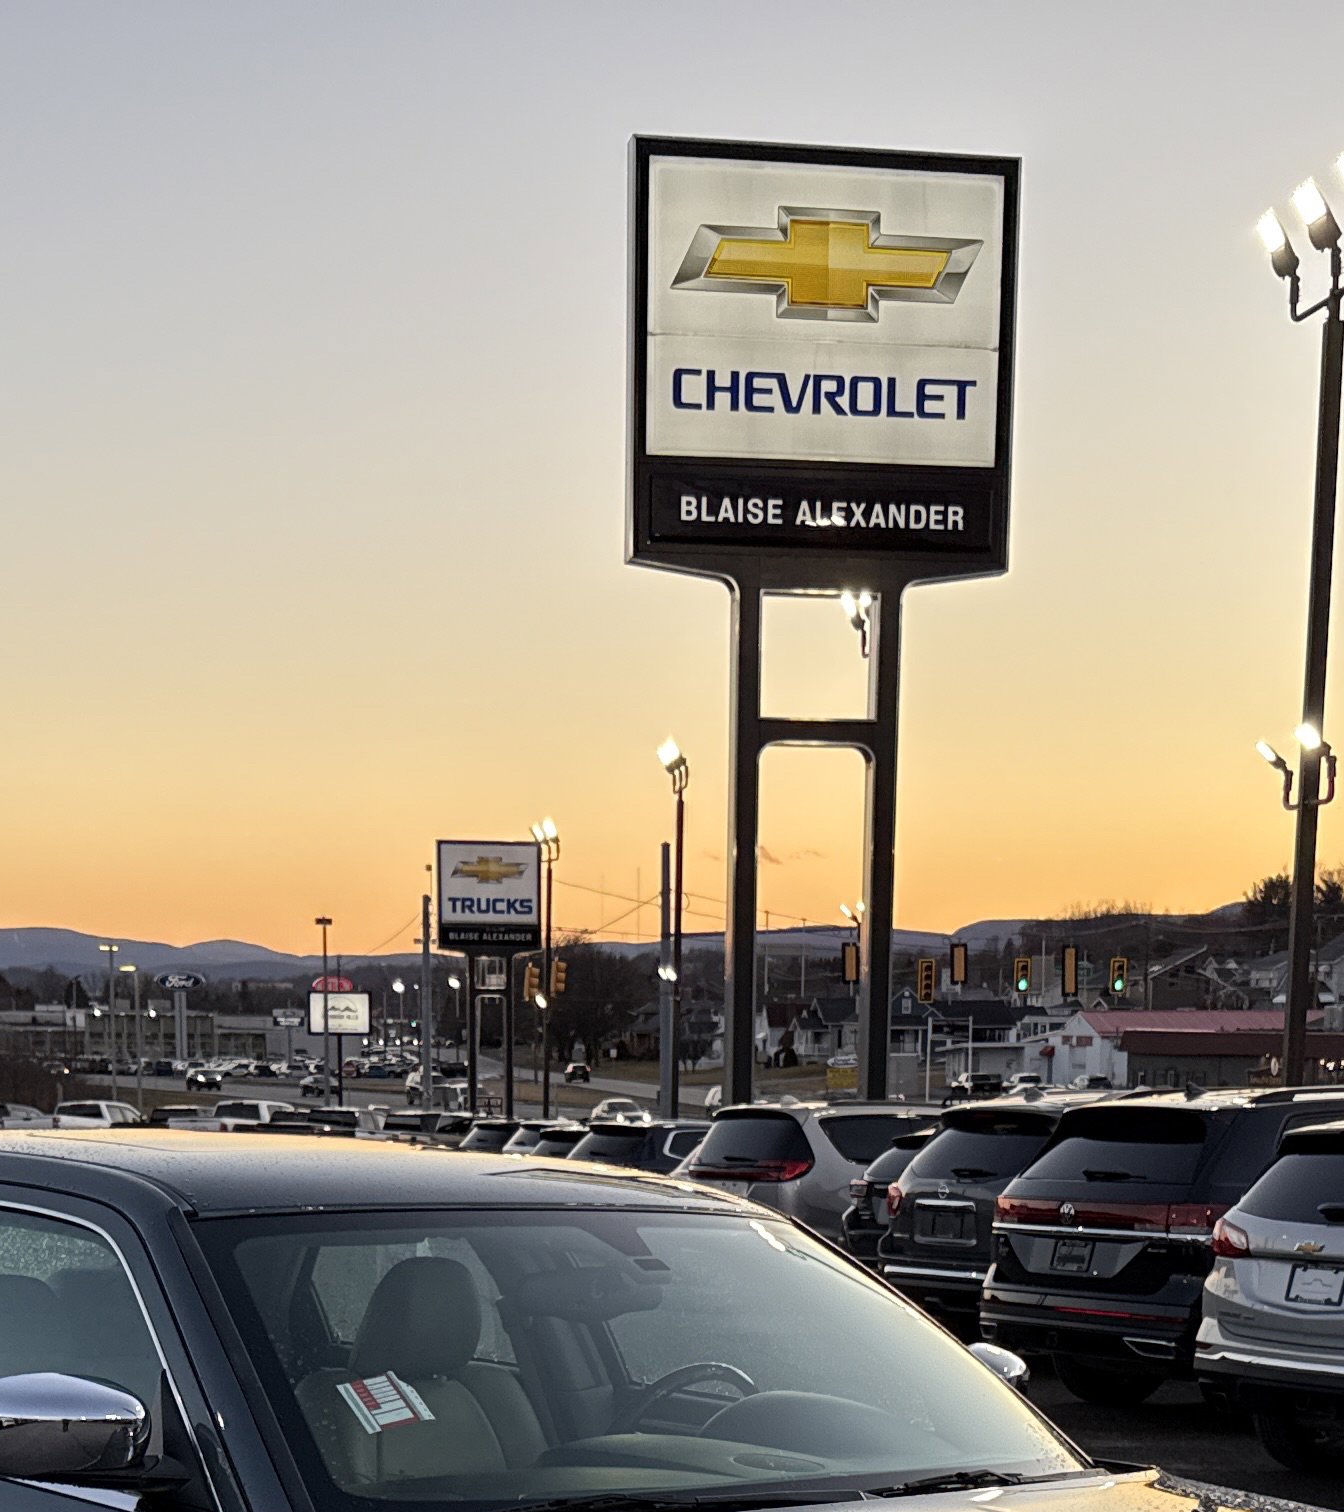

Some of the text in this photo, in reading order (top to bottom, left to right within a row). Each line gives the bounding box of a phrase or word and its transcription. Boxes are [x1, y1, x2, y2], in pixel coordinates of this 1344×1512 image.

[672, 368, 977, 420] CHEVROLET
[680, 495, 965, 531] BLAISE ALEXANDER
[447, 897, 533, 914] TRUCKS
[448, 931, 532, 942] BLAISE ALEXANDER
[166, 975, 195, 988] Ford
